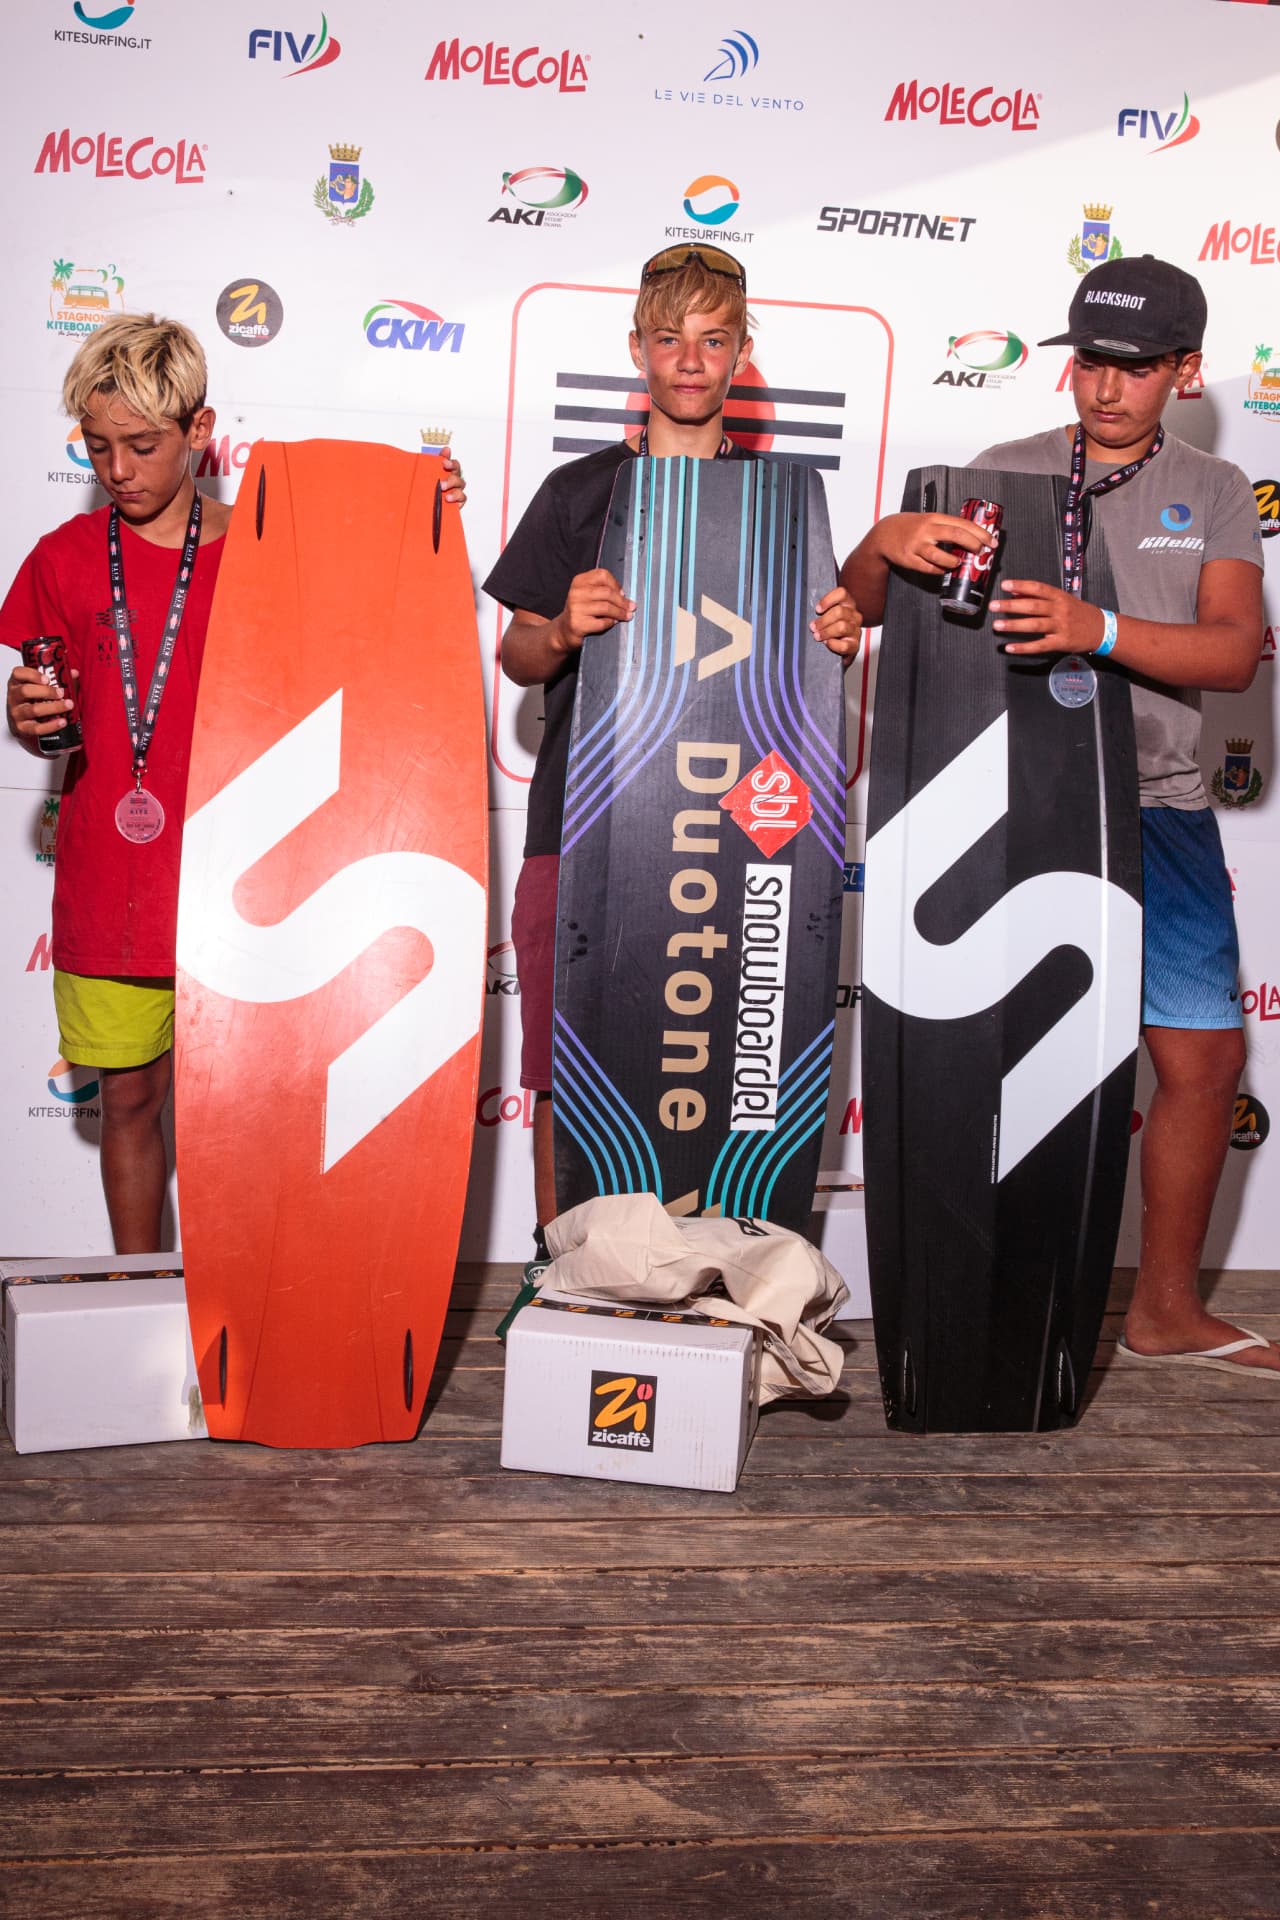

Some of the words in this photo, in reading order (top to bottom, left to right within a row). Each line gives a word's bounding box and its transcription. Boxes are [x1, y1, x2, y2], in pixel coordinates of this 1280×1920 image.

[54, 30, 152, 49] KITESURFING.IT
[248, 29, 316, 63] FIV
[654, 89, 672, 101] LE
[680, 91, 705, 103] VIE
[713, 94, 743, 106] DEL
[751, 97, 804, 111] VENTO
[1117, 108, 1178, 140] FIV
[488, 207, 546, 226] AKI
[816, 206, 977, 242] SPORTNET
[665, 227, 754, 243] KITESURFING.IT
[1198, 219, 1280, 265] MOLE
[1084, 290, 1146, 310] BLACKSHOT
[932, 370, 987, 388] AKI
[47, 471, 98, 484] KITESUR
[750, 770, 798, 832] sbl
[658, 741, 741, 1132] Duotone
[28, 1106, 102, 1118] KITESURFIN
[592, 1429, 651, 1447] zicaffè
